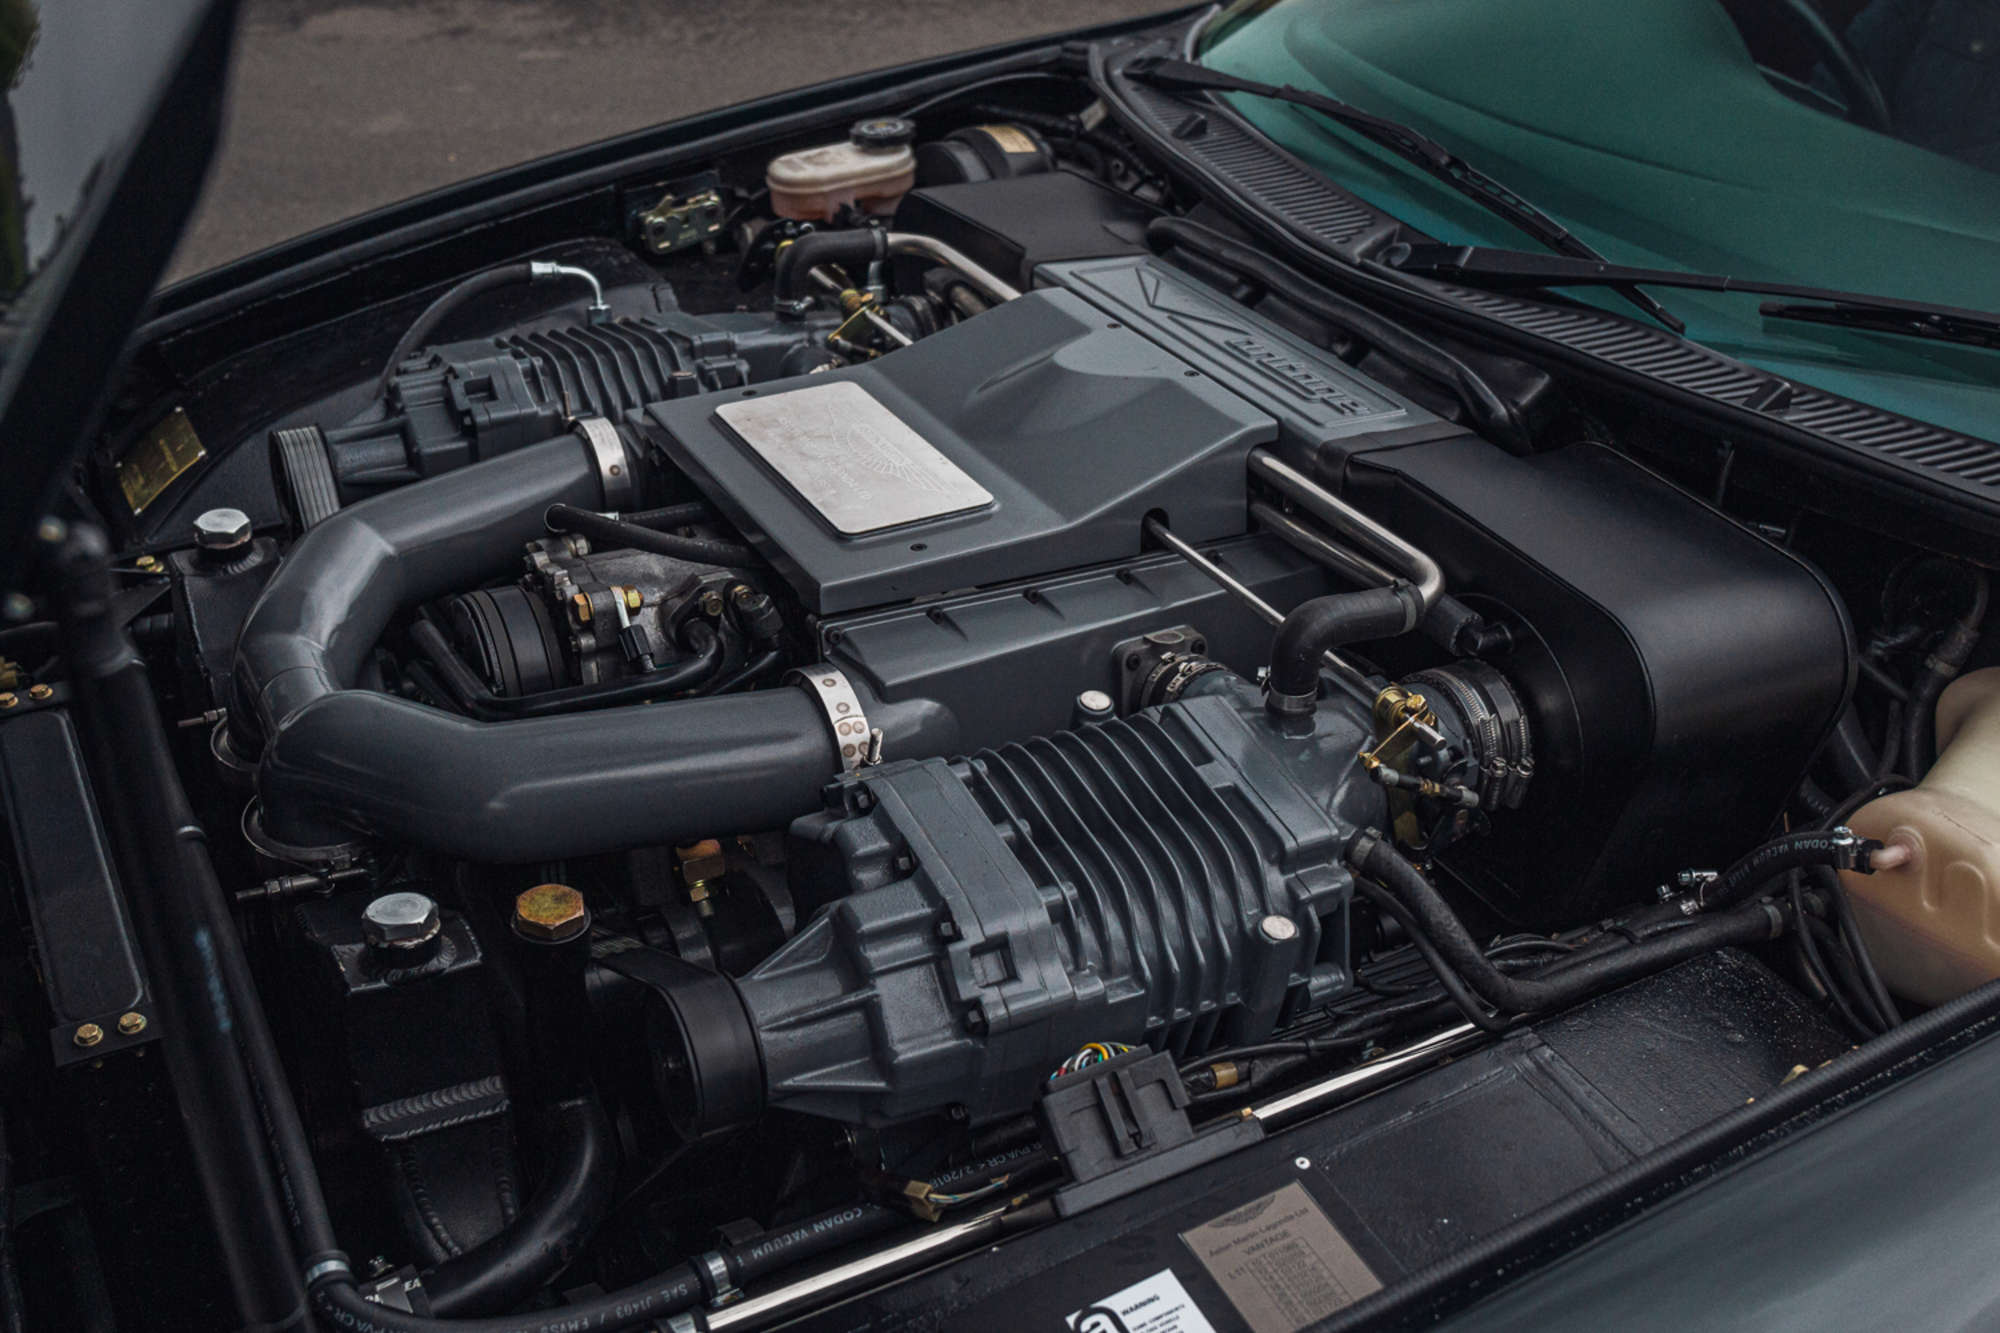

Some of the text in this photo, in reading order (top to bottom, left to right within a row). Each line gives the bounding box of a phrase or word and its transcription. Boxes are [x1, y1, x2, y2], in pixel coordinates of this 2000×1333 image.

[752, 1207, 863, 1259] CODAN VACUUM
[660, 1283, 688, 1303] SAE
[1121, 1294, 1160, 1316] WARNING
